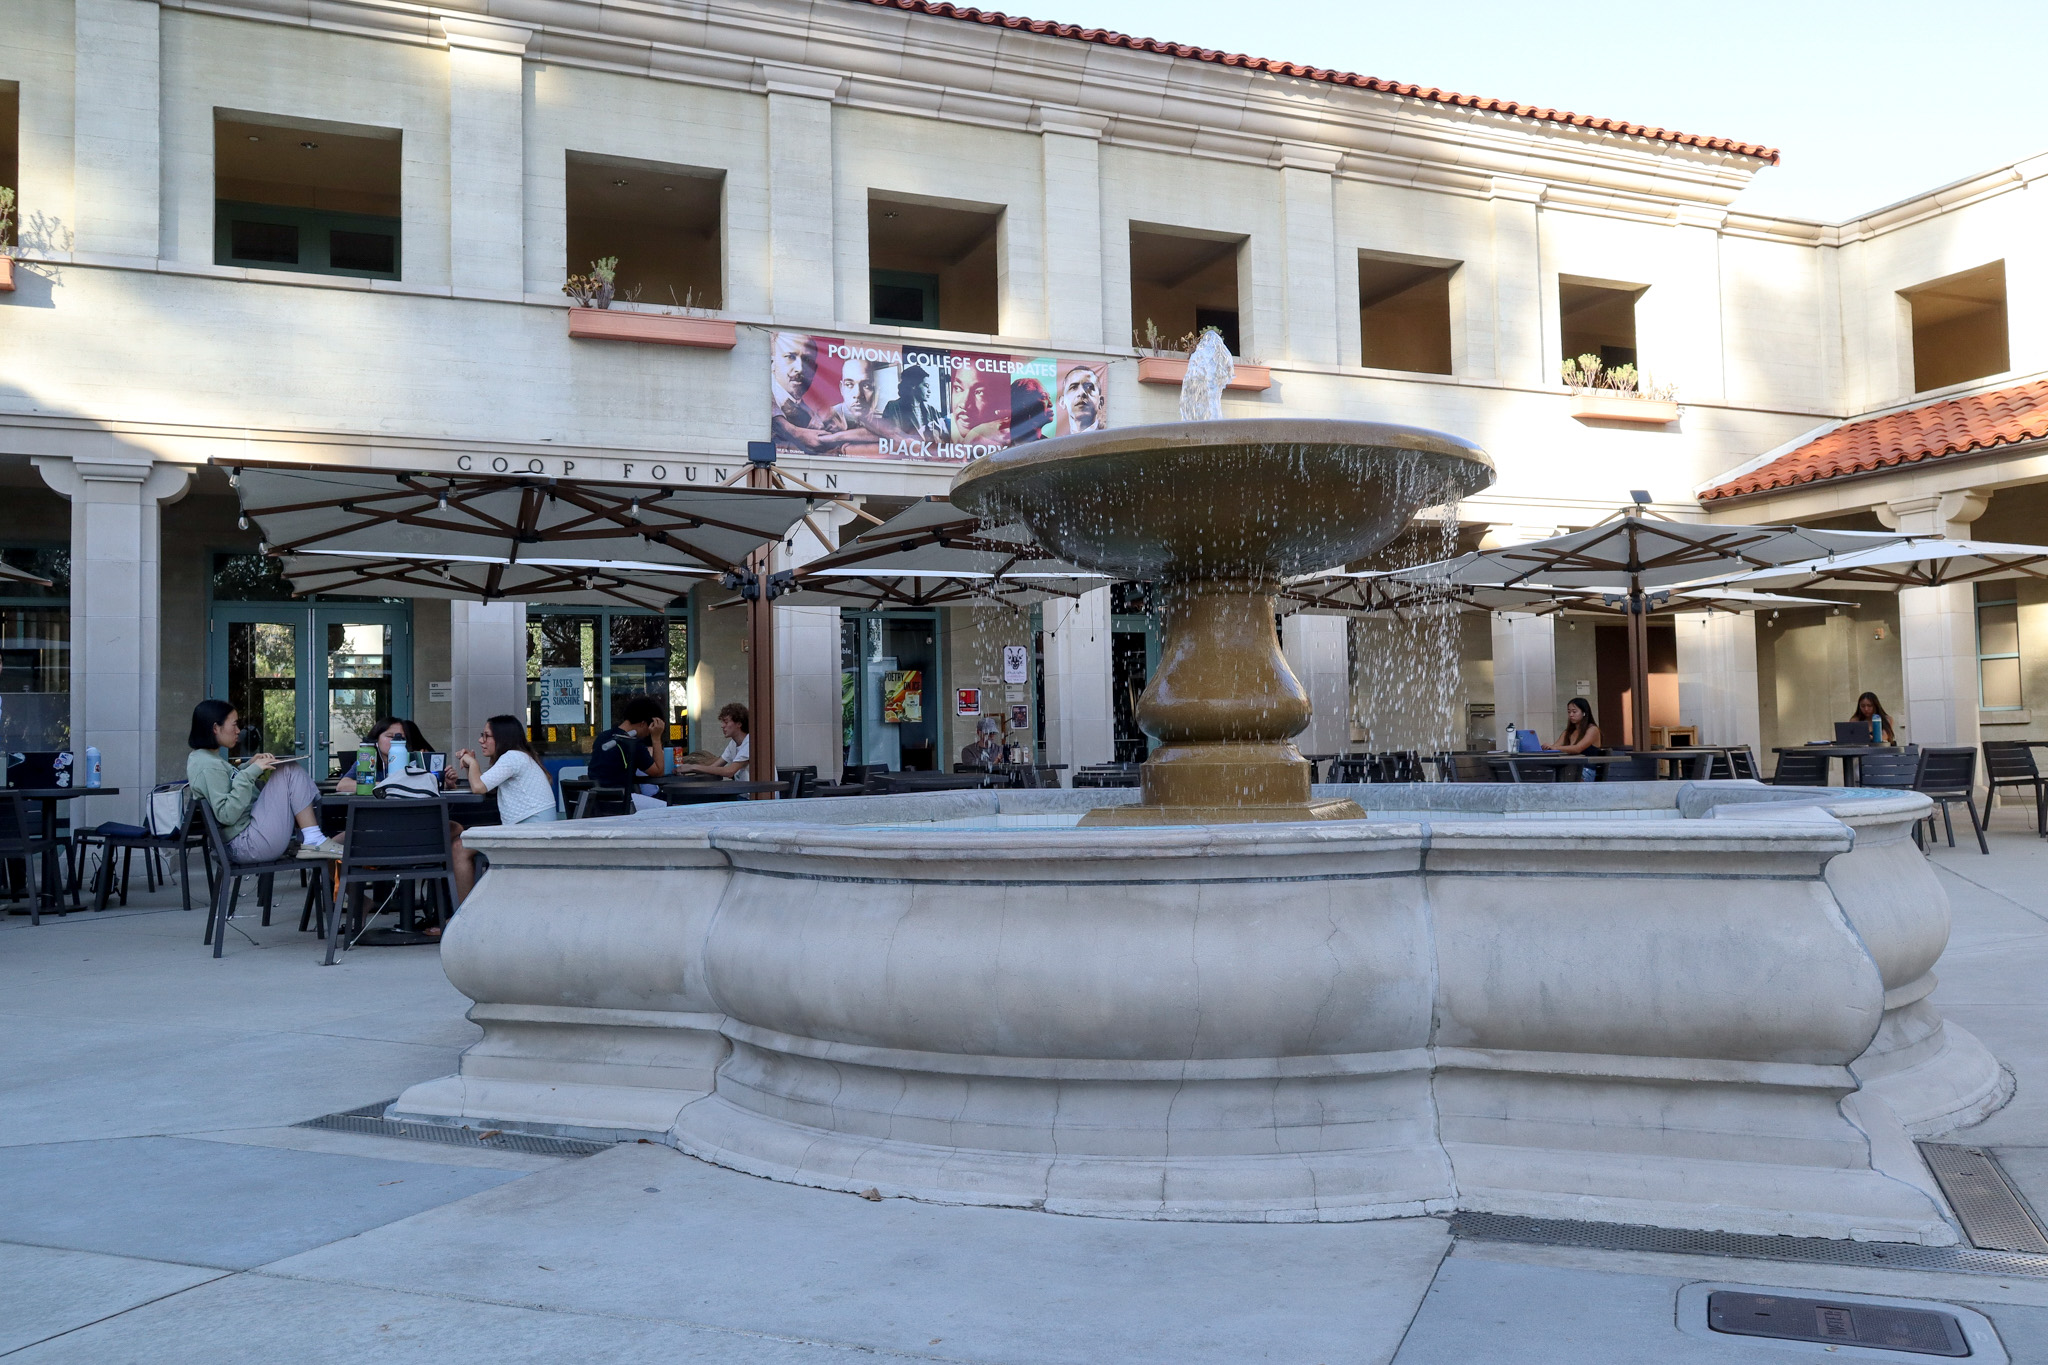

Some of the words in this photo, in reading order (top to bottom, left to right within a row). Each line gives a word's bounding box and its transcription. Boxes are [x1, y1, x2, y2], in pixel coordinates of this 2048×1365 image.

[828, 344, 903, 364] POMONA
[906, 351, 971, 371] COLLEGE
[975, 358, 1057, 378] CELEBRATES
[878, 437, 934, 458] BLACK
[457, 455, 575, 476] COOP
[622, 463, 838, 489] FOUNIN
[552, 678, 573, 688] TASTES
[568, 687, 581, 697] LIKE
[552, 696, 581, 706] SUNSHINE
[1824, 1310, 1847, 1335] WATER
